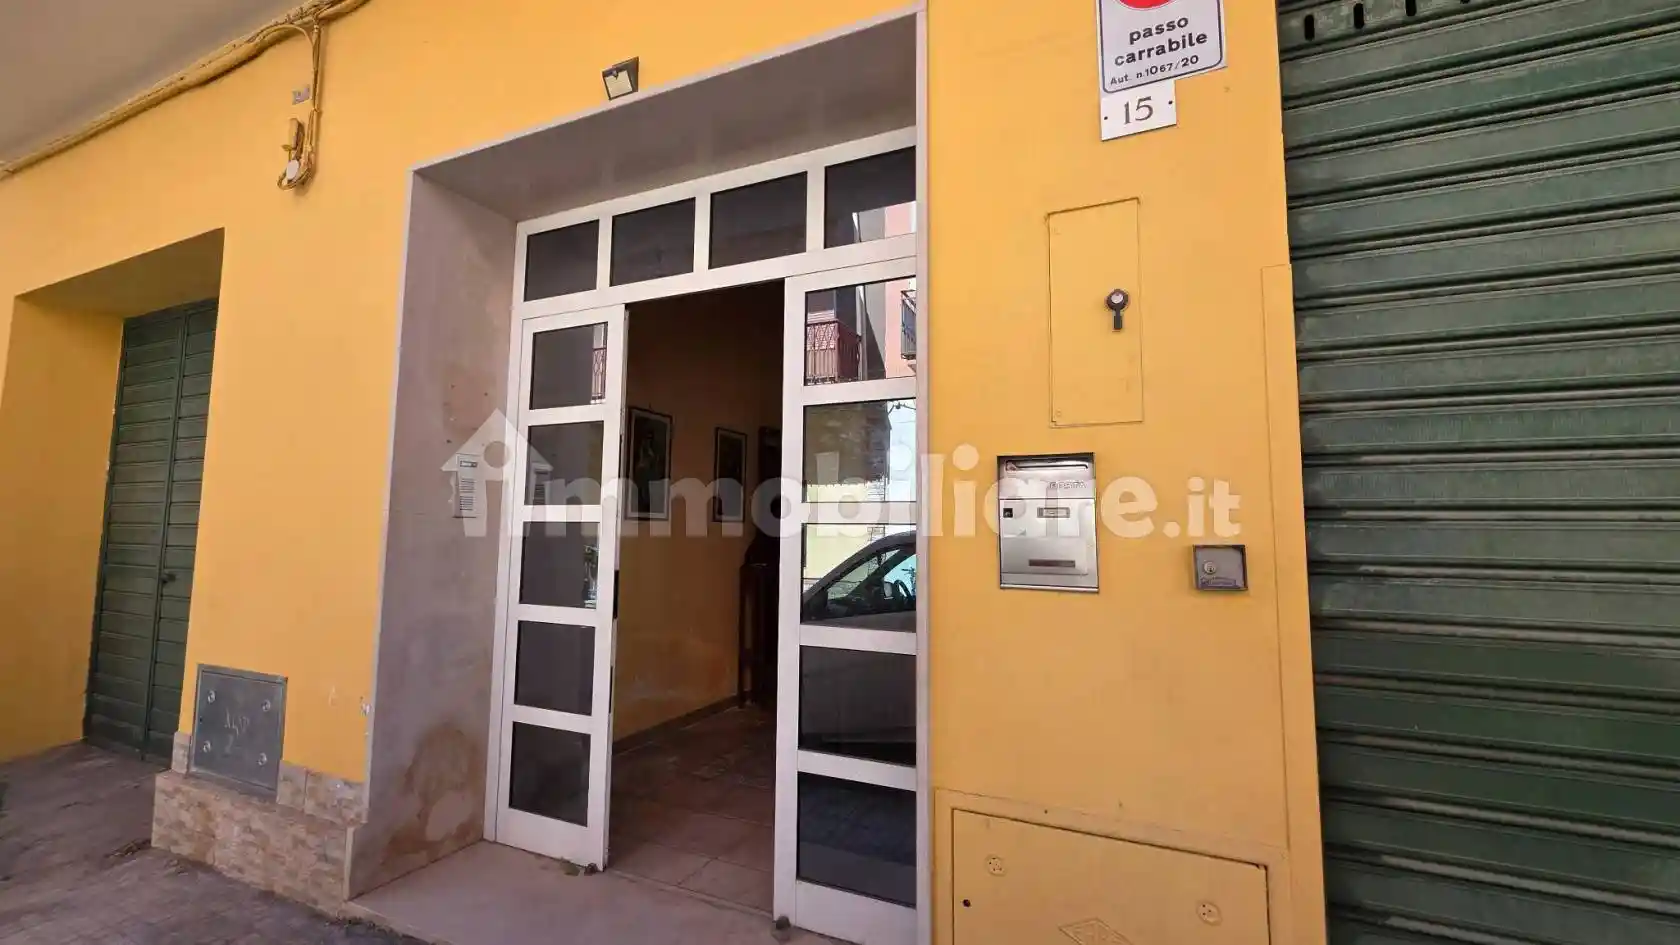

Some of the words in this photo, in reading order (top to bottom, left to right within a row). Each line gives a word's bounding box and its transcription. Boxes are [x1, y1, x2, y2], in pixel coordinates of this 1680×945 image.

[1129, 17, 1189, 45] passo
[1114, 33, 1208, 66] carrabile
[1124, 96, 1154, 125] 15
